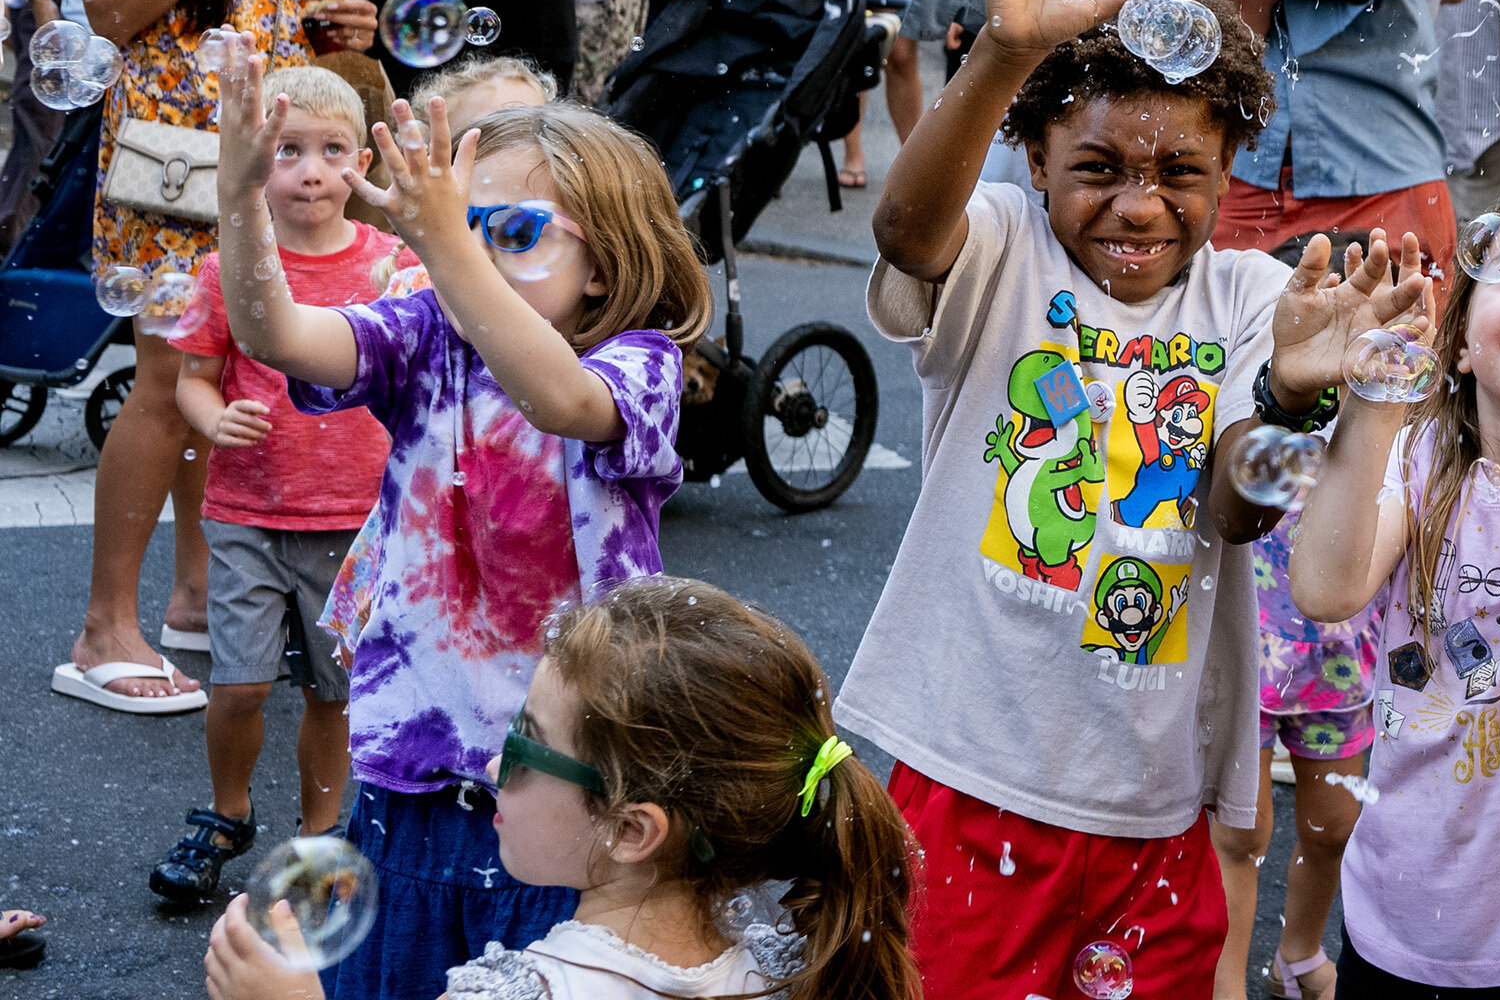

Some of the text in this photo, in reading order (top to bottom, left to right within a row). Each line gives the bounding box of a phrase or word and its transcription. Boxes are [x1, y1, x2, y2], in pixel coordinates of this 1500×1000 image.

[1046, 290, 1120, 368] SER
[984, 558, 1066, 613] YOSHI
[1097, 659, 1166, 692] LUIGI
